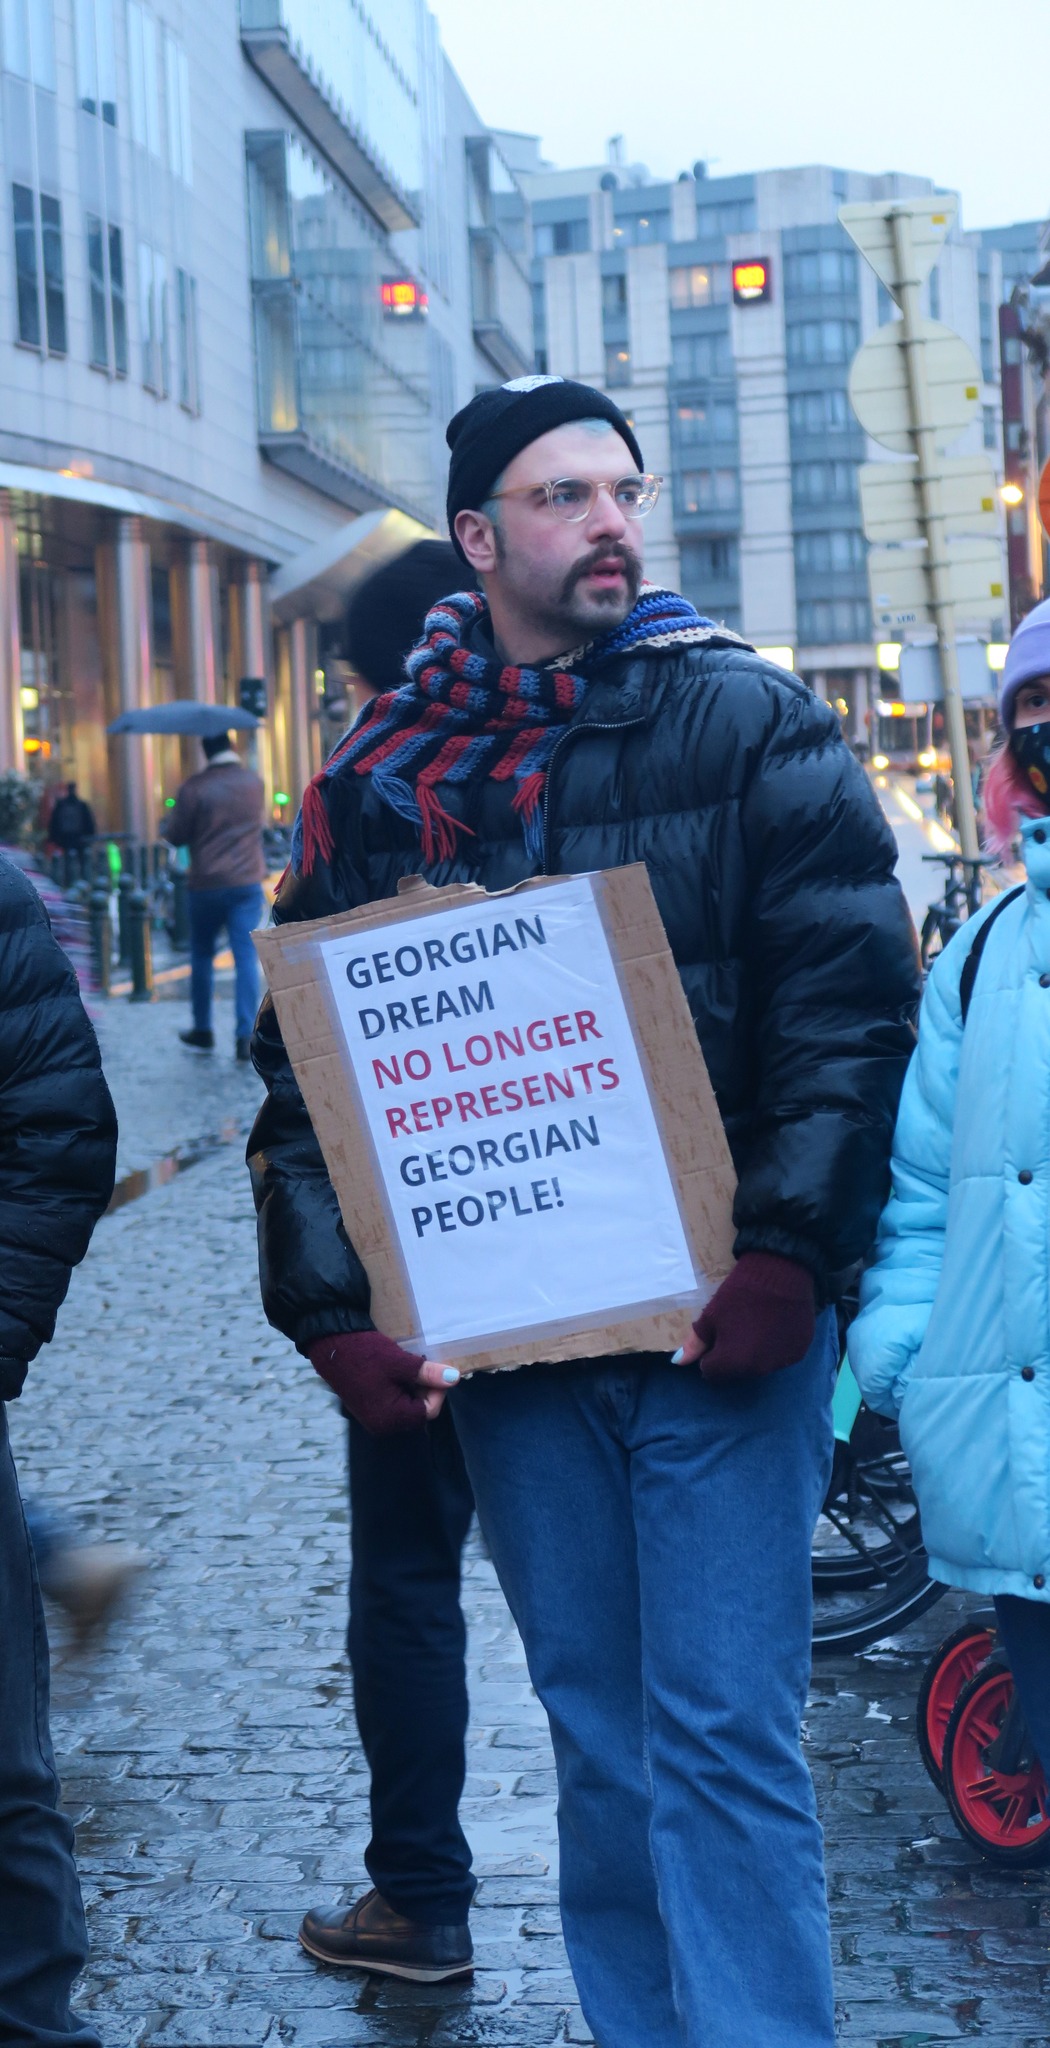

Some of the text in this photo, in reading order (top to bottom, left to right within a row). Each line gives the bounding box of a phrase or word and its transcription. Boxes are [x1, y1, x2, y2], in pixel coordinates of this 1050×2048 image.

[345, 914, 547, 989] GEORGIAN
[357, 980, 495, 1041] DREAM
[371, 1009, 604, 1090] NO LONGER
[384, 1057, 620, 1139] REPRESENTS
[399, 1114, 601, 1187] GEORGIAN
[410, 1176, 565, 1238] PEOPLE!
